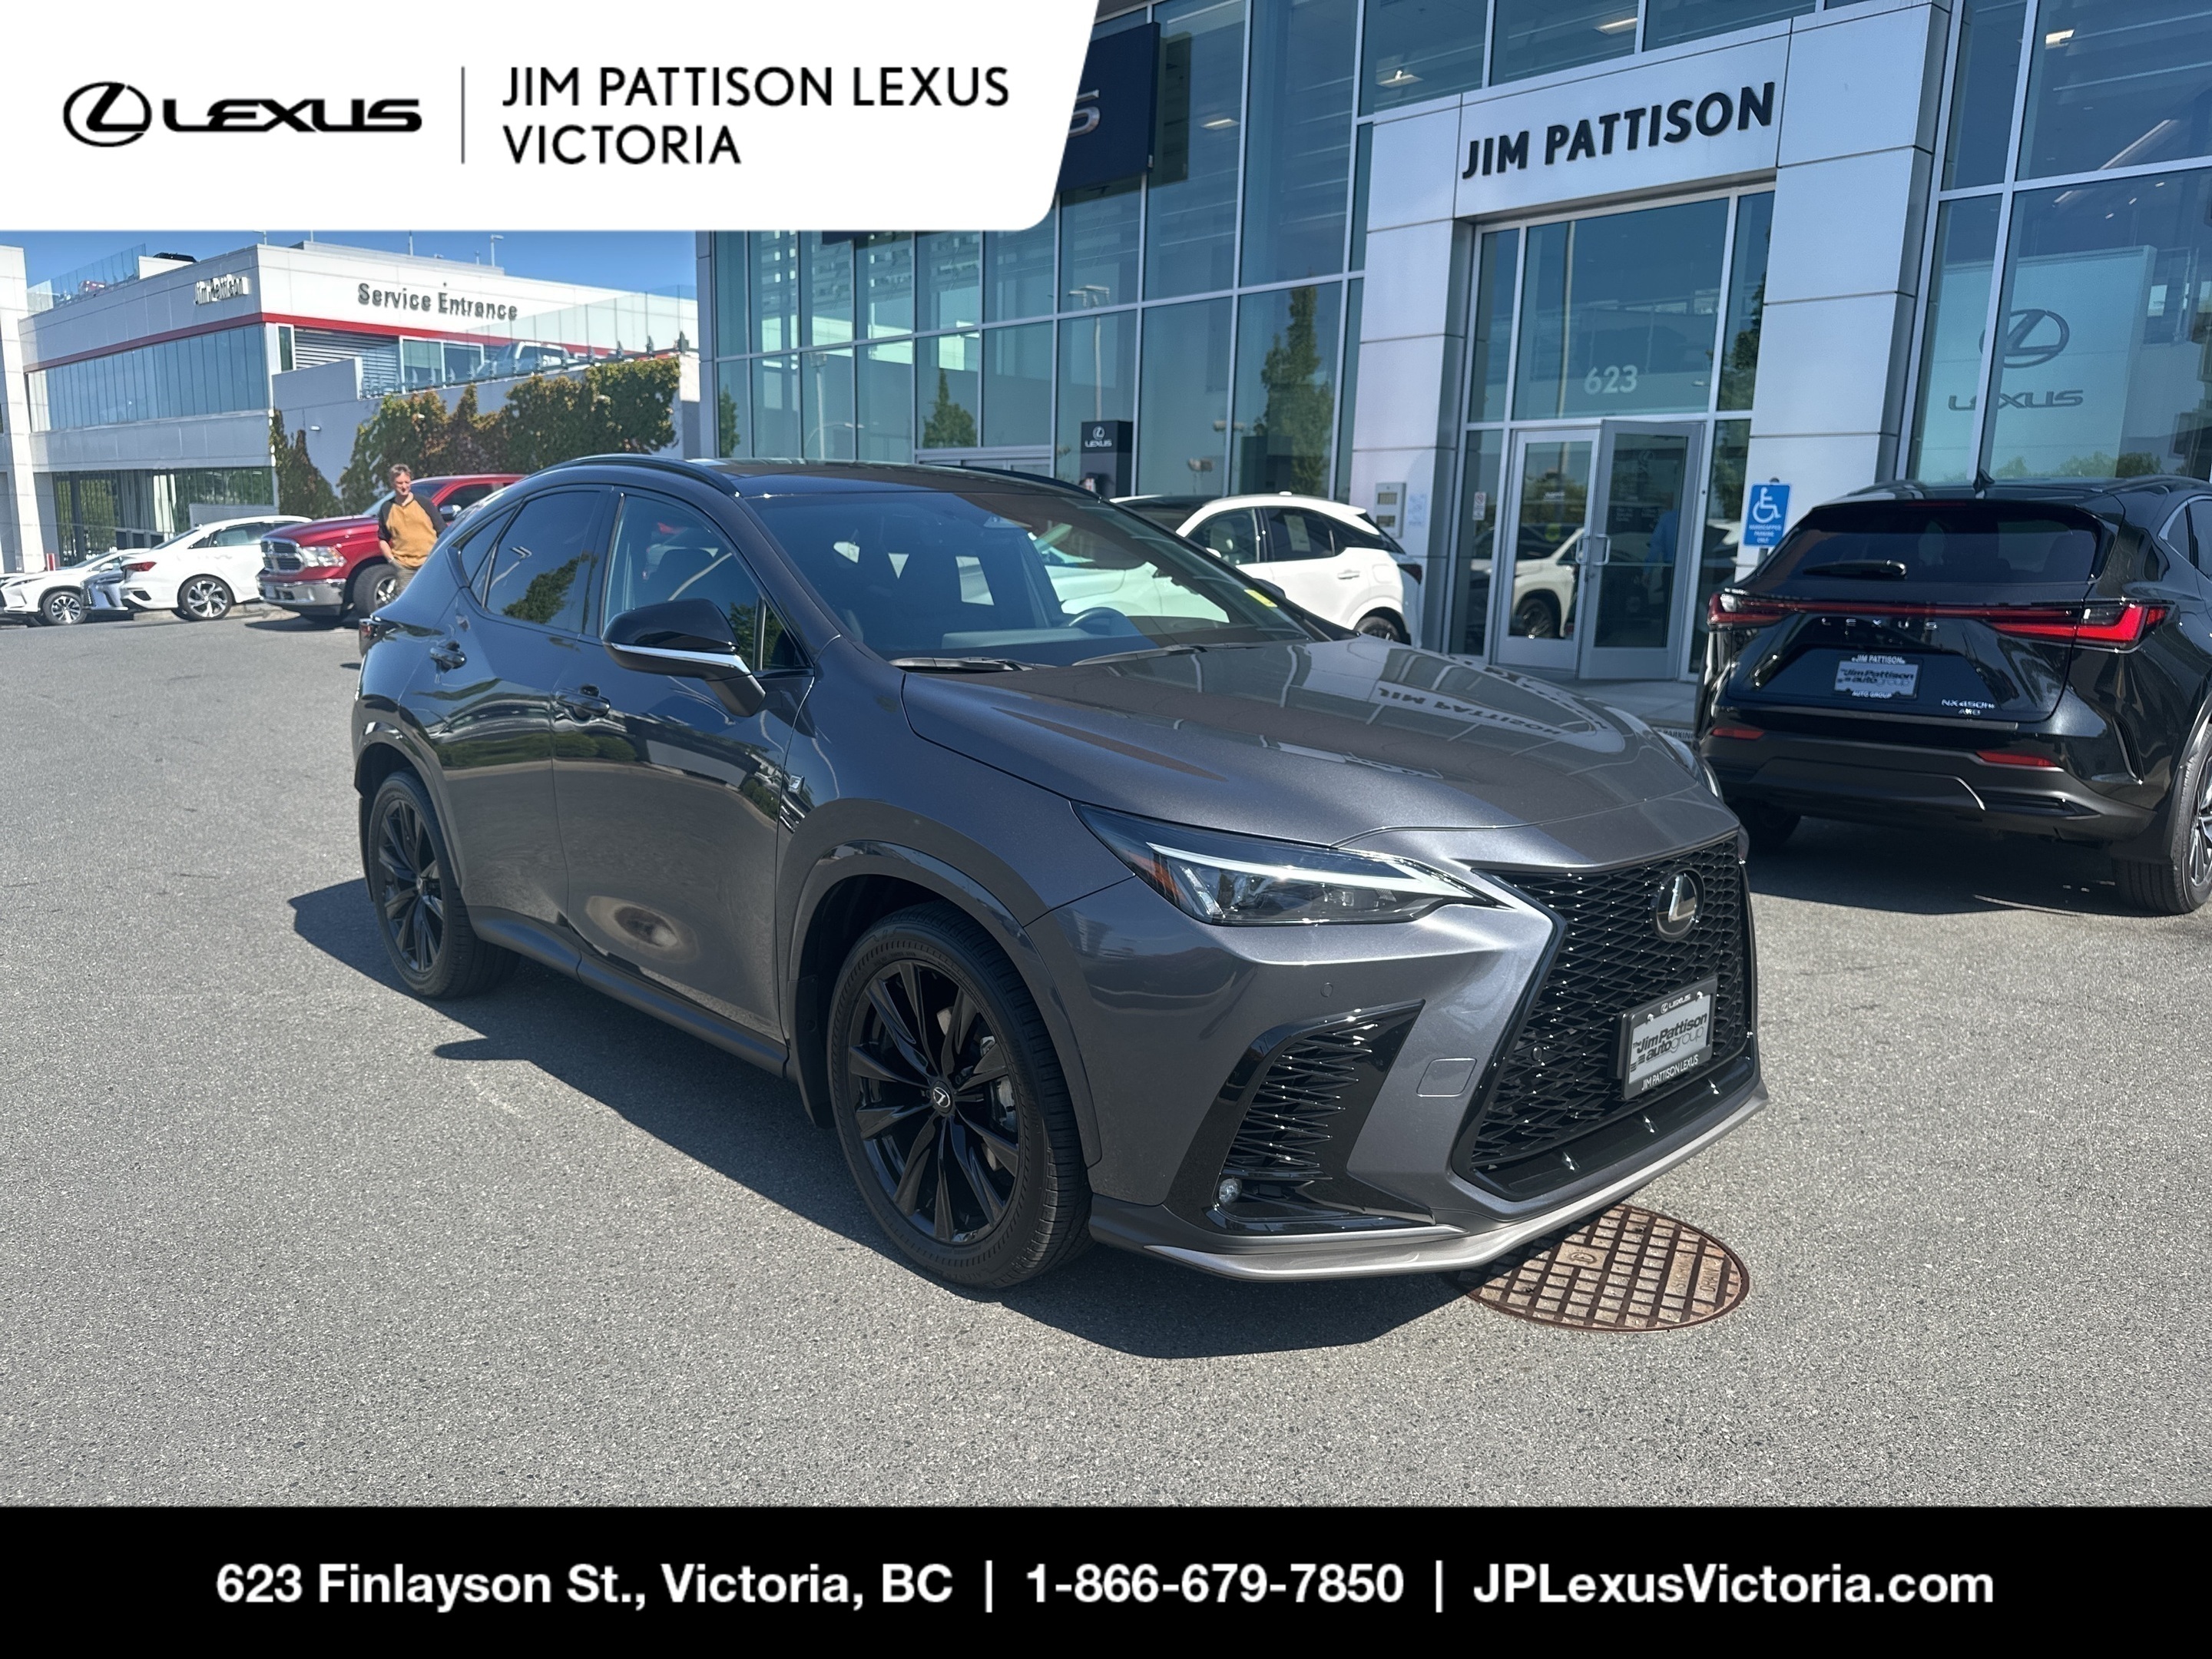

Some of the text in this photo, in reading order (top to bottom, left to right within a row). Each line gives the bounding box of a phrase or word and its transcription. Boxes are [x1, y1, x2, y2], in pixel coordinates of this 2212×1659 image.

[1462, 81, 1776, 180] JIM PATTISON
[358, 283, 518, 320] Service Entrance
[1584, 365, 1637, 396] 623
[1084, 439, 1113, 448] LEXUS
[1869, 655, 1902, 665] PATTISON
[1668, 993, 1692, 1009] LEXUS
[1637, 1034, 1659, 1054] Jim
[1659, 1012, 1707, 1043] Pattison
[1641, 1054, 1699, 1091] JIM PATTISON LEXUS
